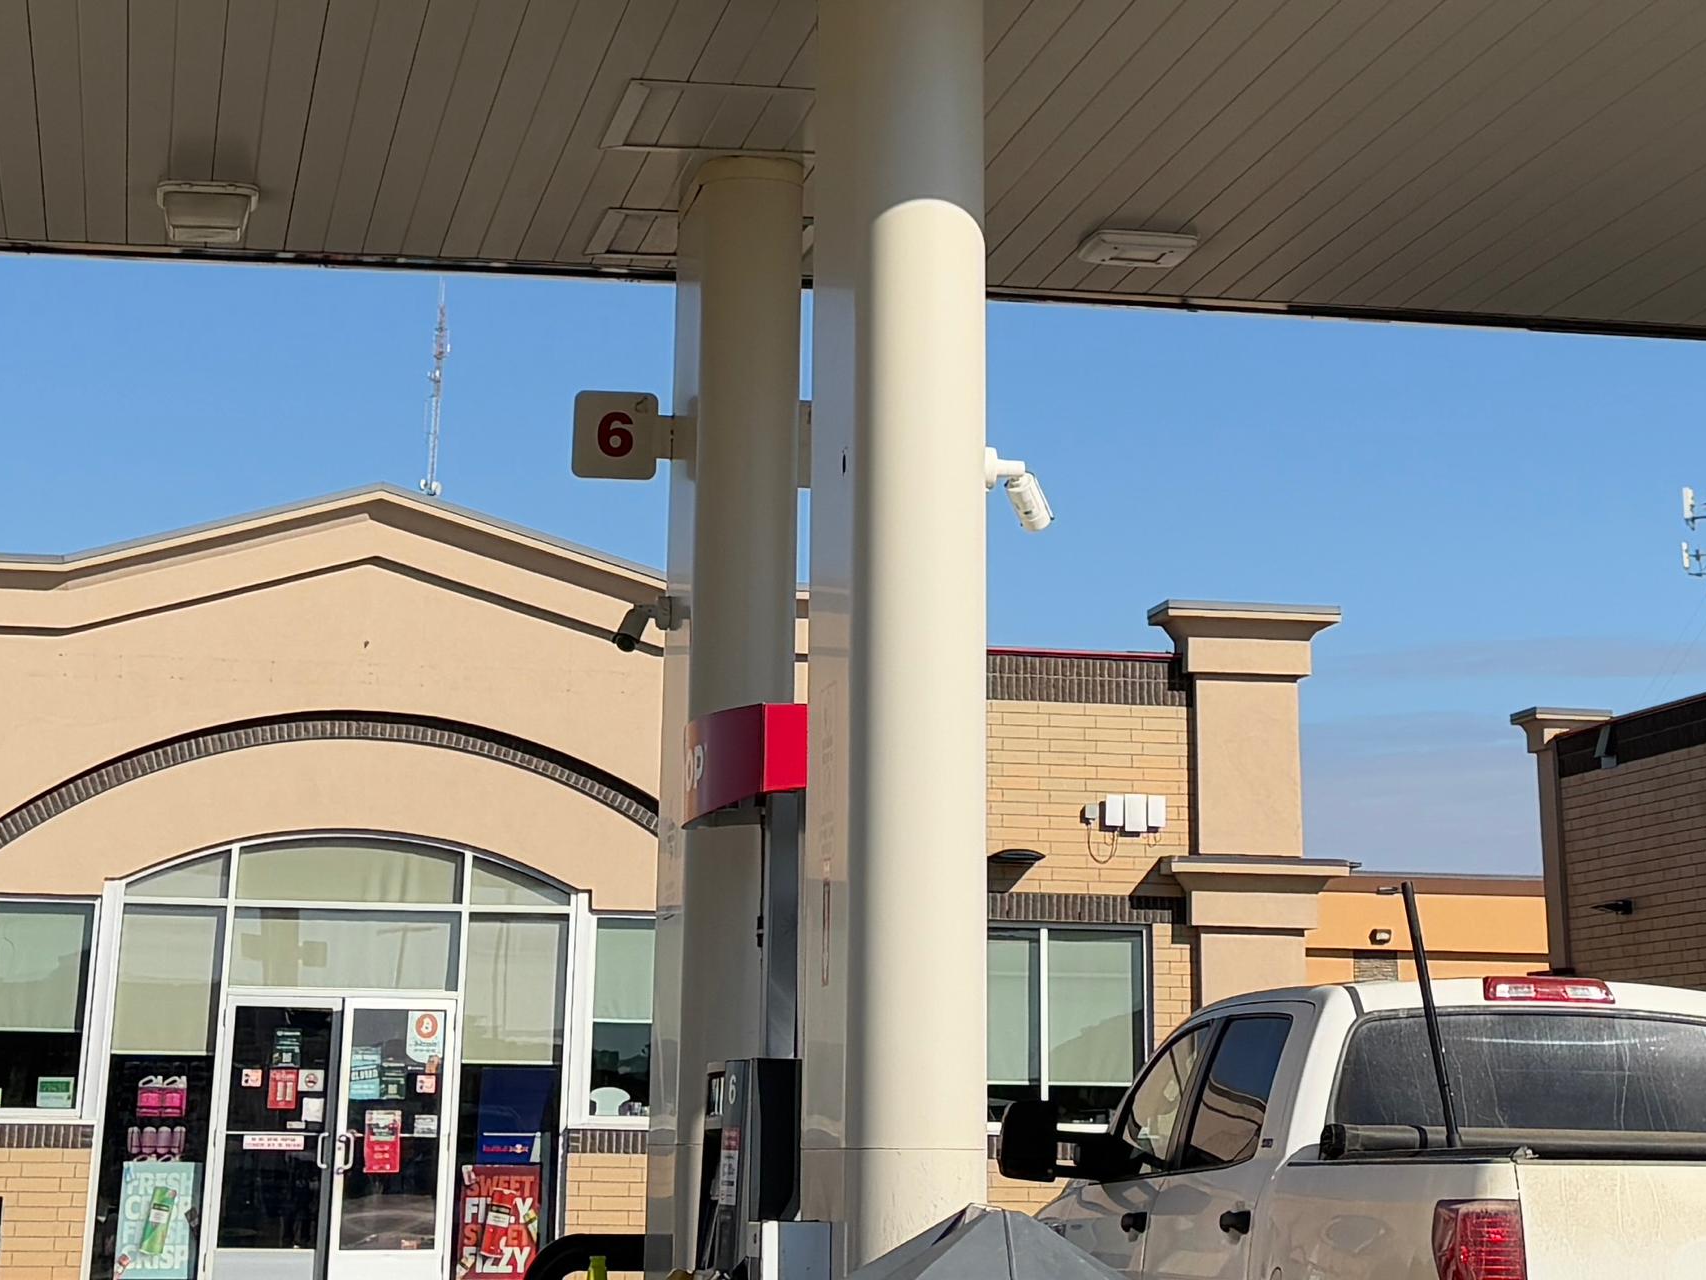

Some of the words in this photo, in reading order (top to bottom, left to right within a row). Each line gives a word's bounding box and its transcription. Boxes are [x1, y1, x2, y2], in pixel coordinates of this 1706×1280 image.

[597, 411, 634, 458] 6
[728, 1074, 737, 1105] 6
[464, 1197, 533, 1223] FIY
